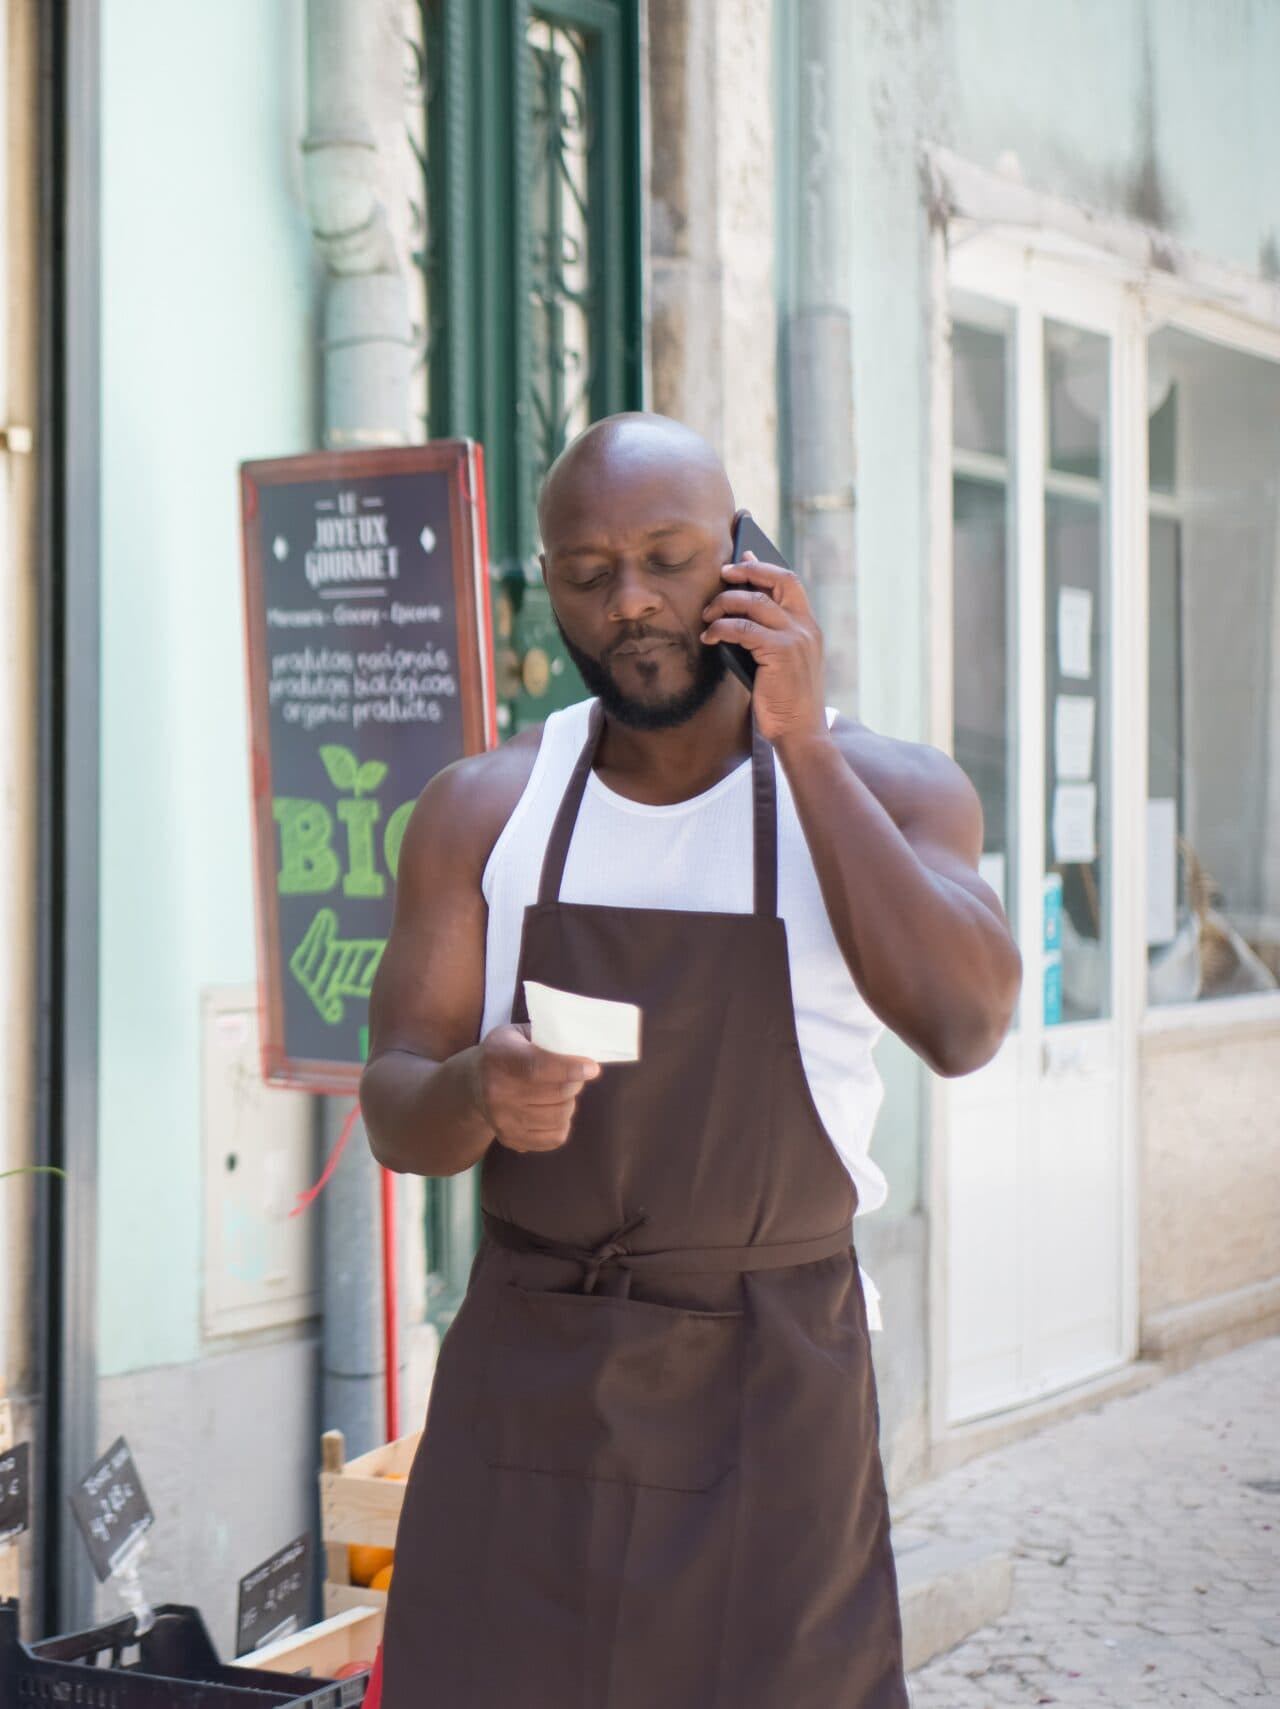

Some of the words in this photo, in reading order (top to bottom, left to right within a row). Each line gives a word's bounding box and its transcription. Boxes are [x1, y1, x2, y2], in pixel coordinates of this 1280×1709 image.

[314, 515, 389, 548] JOYEUX
[305, 546, 399, 590] GOURMET
[352, 696, 442, 730] products
